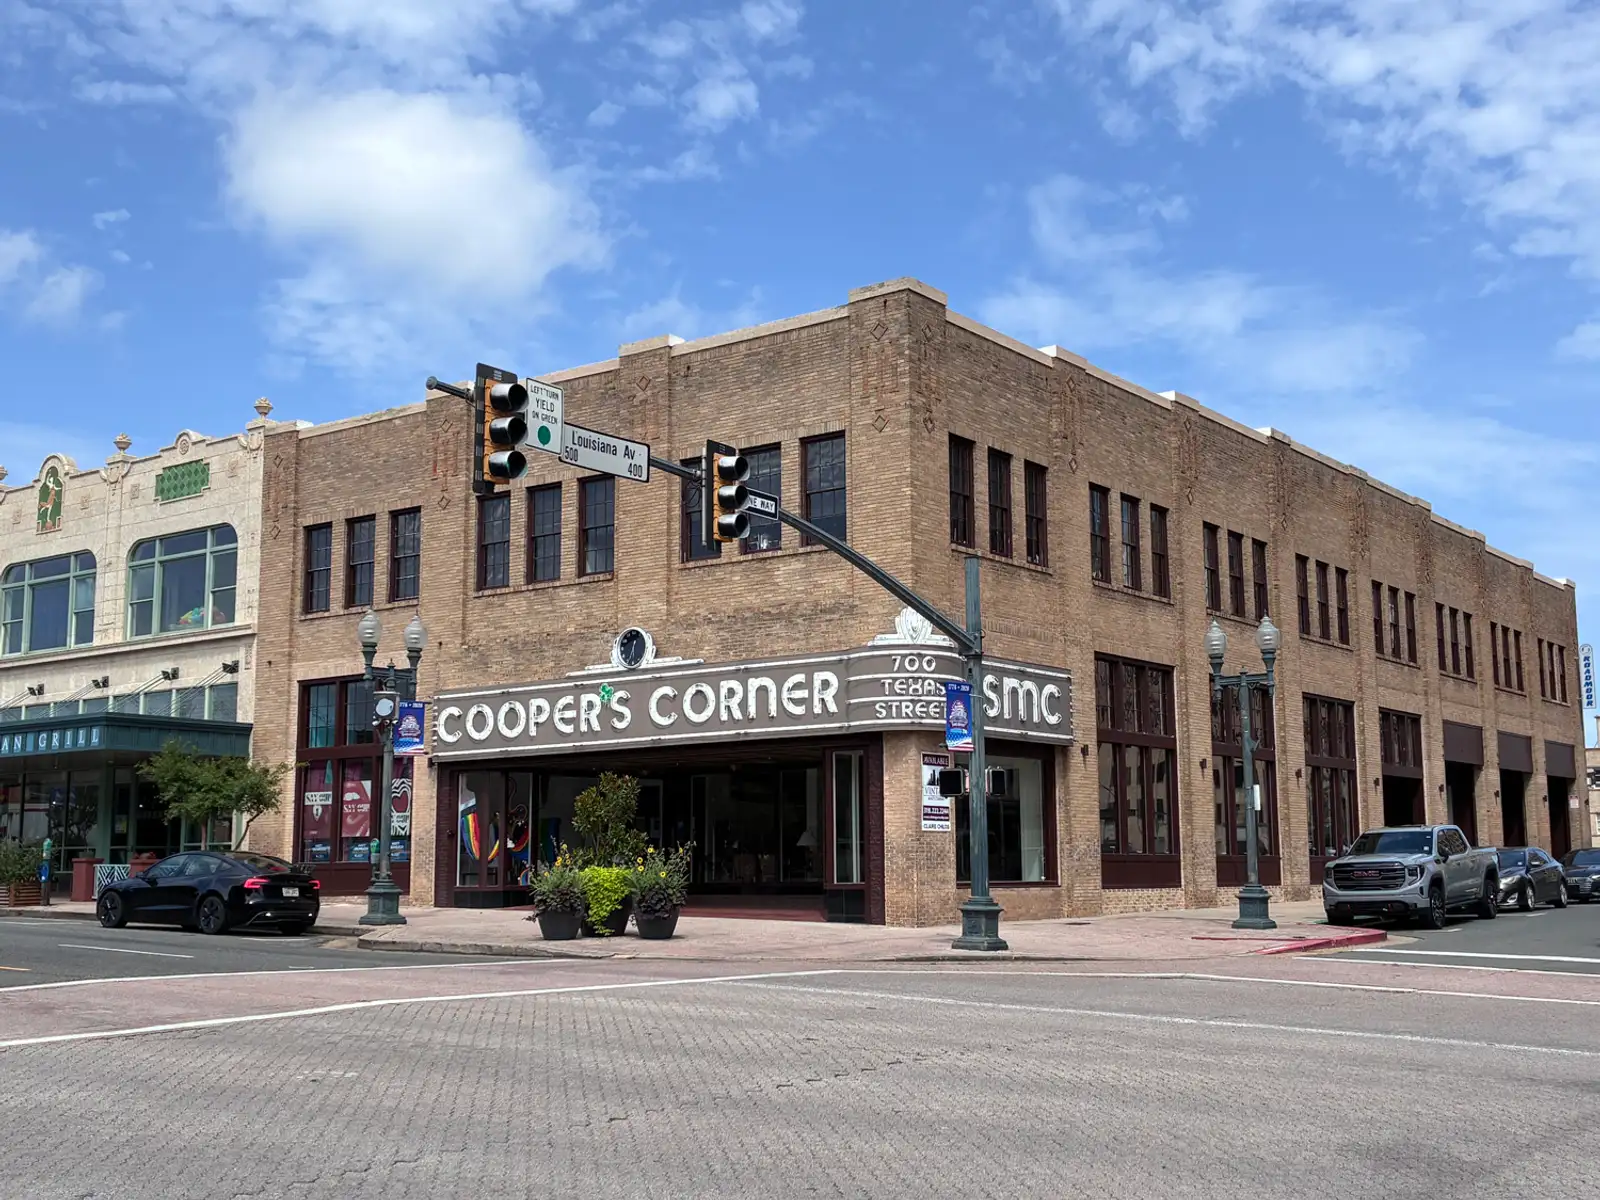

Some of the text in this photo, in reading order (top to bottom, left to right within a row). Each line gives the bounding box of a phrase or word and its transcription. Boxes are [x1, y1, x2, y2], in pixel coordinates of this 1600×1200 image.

[530, 384, 559, 401] LEFT TURN
[535, 398, 555, 412] YIELD
[532, 410, 558, 425] ON GREEN
[571, 430, 636, 460] Louisiana Av
[564, 446, 579, 462] 500
[627, 463, 643, 478] 400
[760, 500, 775, 511] WAY
[891, 655, 936, 673] 700
[881, 678, 947, 696] TEXAS
[436, 670, 839, 744] COOPER'S CORNER
[982, 674, 1063, 726] SMC
[39, 728, 100, 748] GRILL
[923, 756, 949, 765] AVAILABLE
